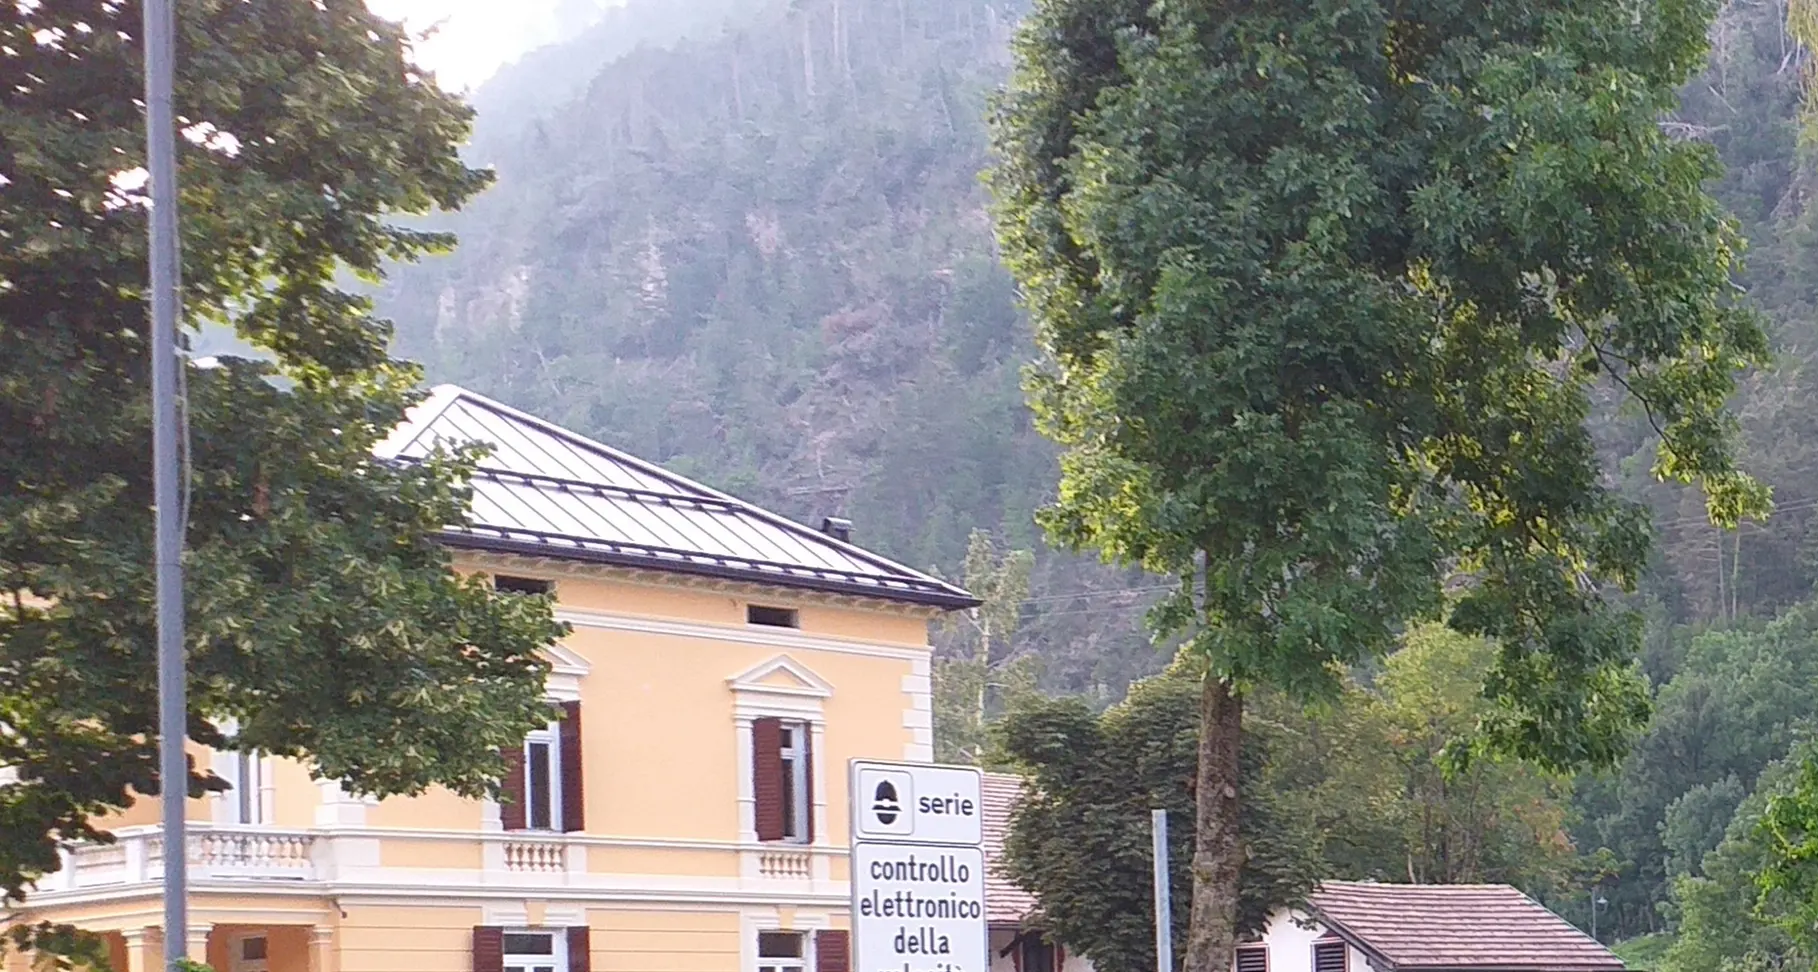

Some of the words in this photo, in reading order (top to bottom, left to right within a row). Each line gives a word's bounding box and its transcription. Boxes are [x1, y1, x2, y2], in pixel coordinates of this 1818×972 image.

[919, 794, 974, 816] serie
[870, 855, 969, 883] controllo
[860, 889, 981, 919] elettronico
[894, 927, 950, 954] della
